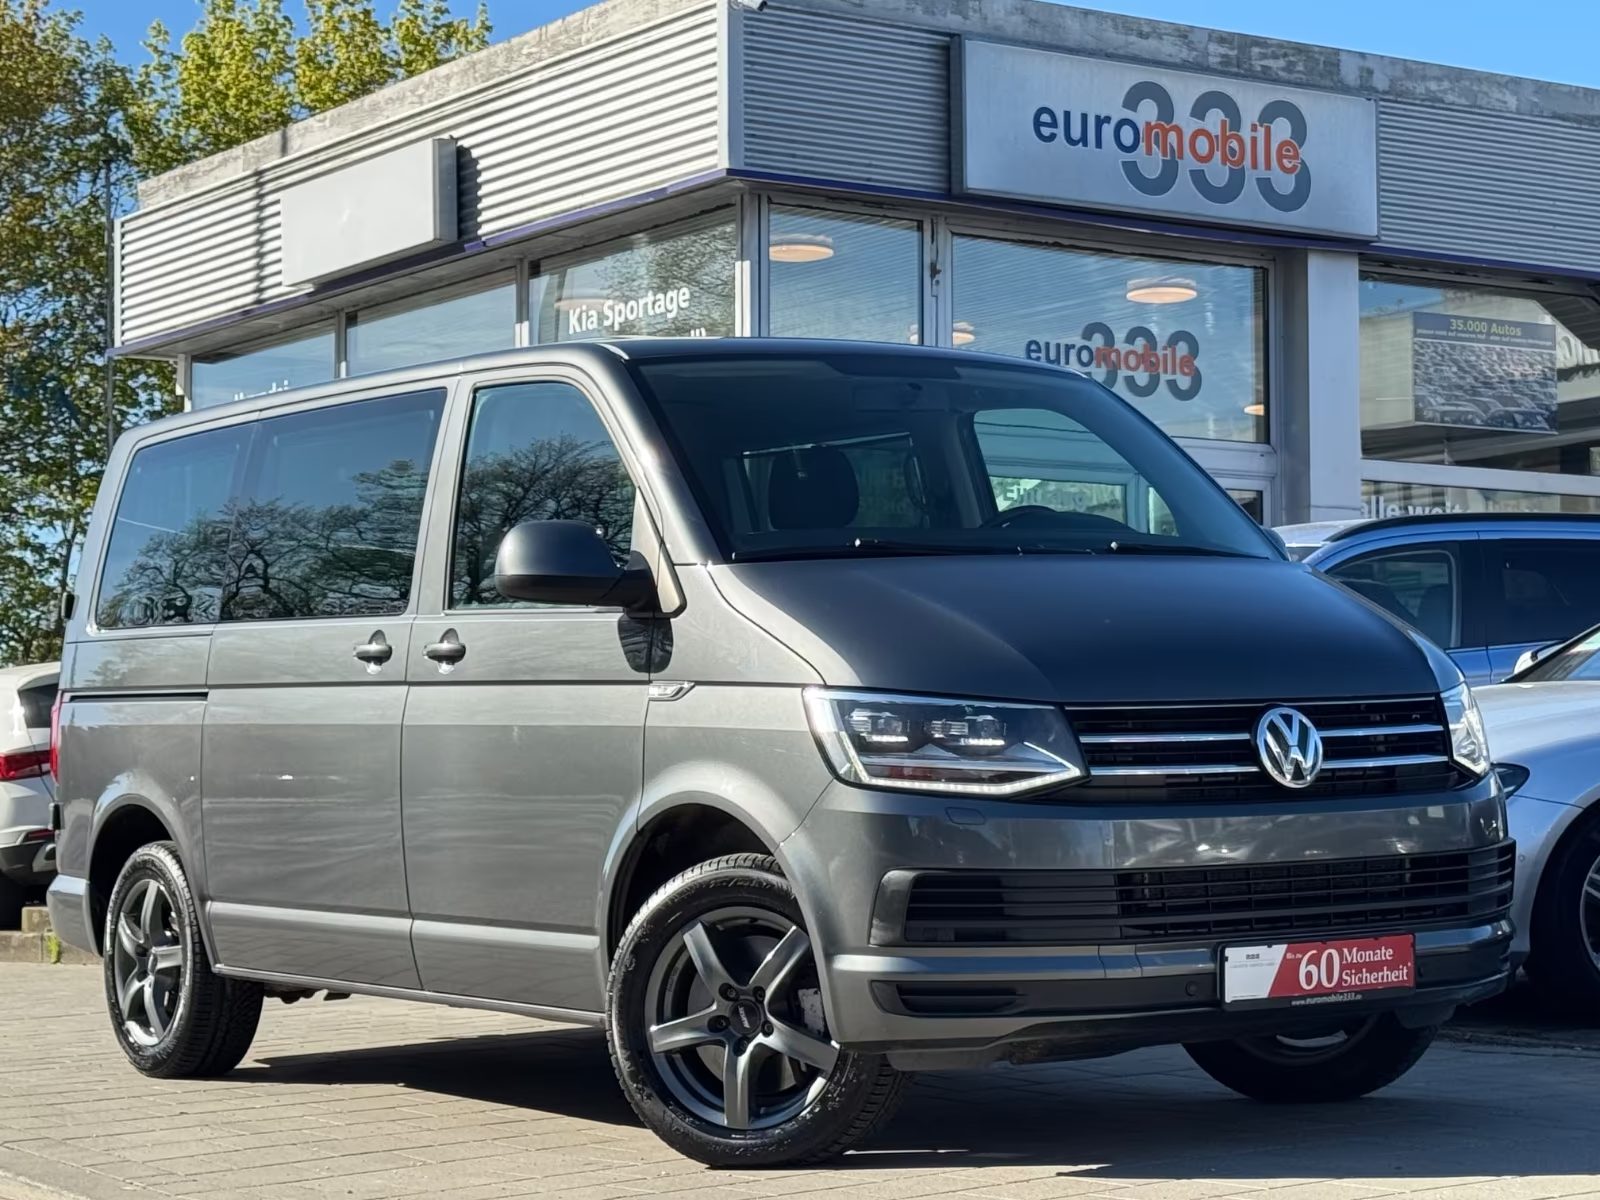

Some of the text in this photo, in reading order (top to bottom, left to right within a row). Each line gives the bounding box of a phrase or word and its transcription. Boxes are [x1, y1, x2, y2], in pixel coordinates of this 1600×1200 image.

[1033, 106, 1301, 174] euromobile
[1121, 81, 1311, 213] 333
[568, 287, 691, 334] Kia Sportage
[1449, 318, 1488, 333] 35.000
[1490, 322, 1522, 337] Autos
[1025, 339, 1196, 377] euromobile
[1081, 322, 1203, 402] 333
[1299, 949, 1340, 990] 60
[1342, 946, 1393, 964] Monate
[1342, 965, 1409, 986] Sicherheit
